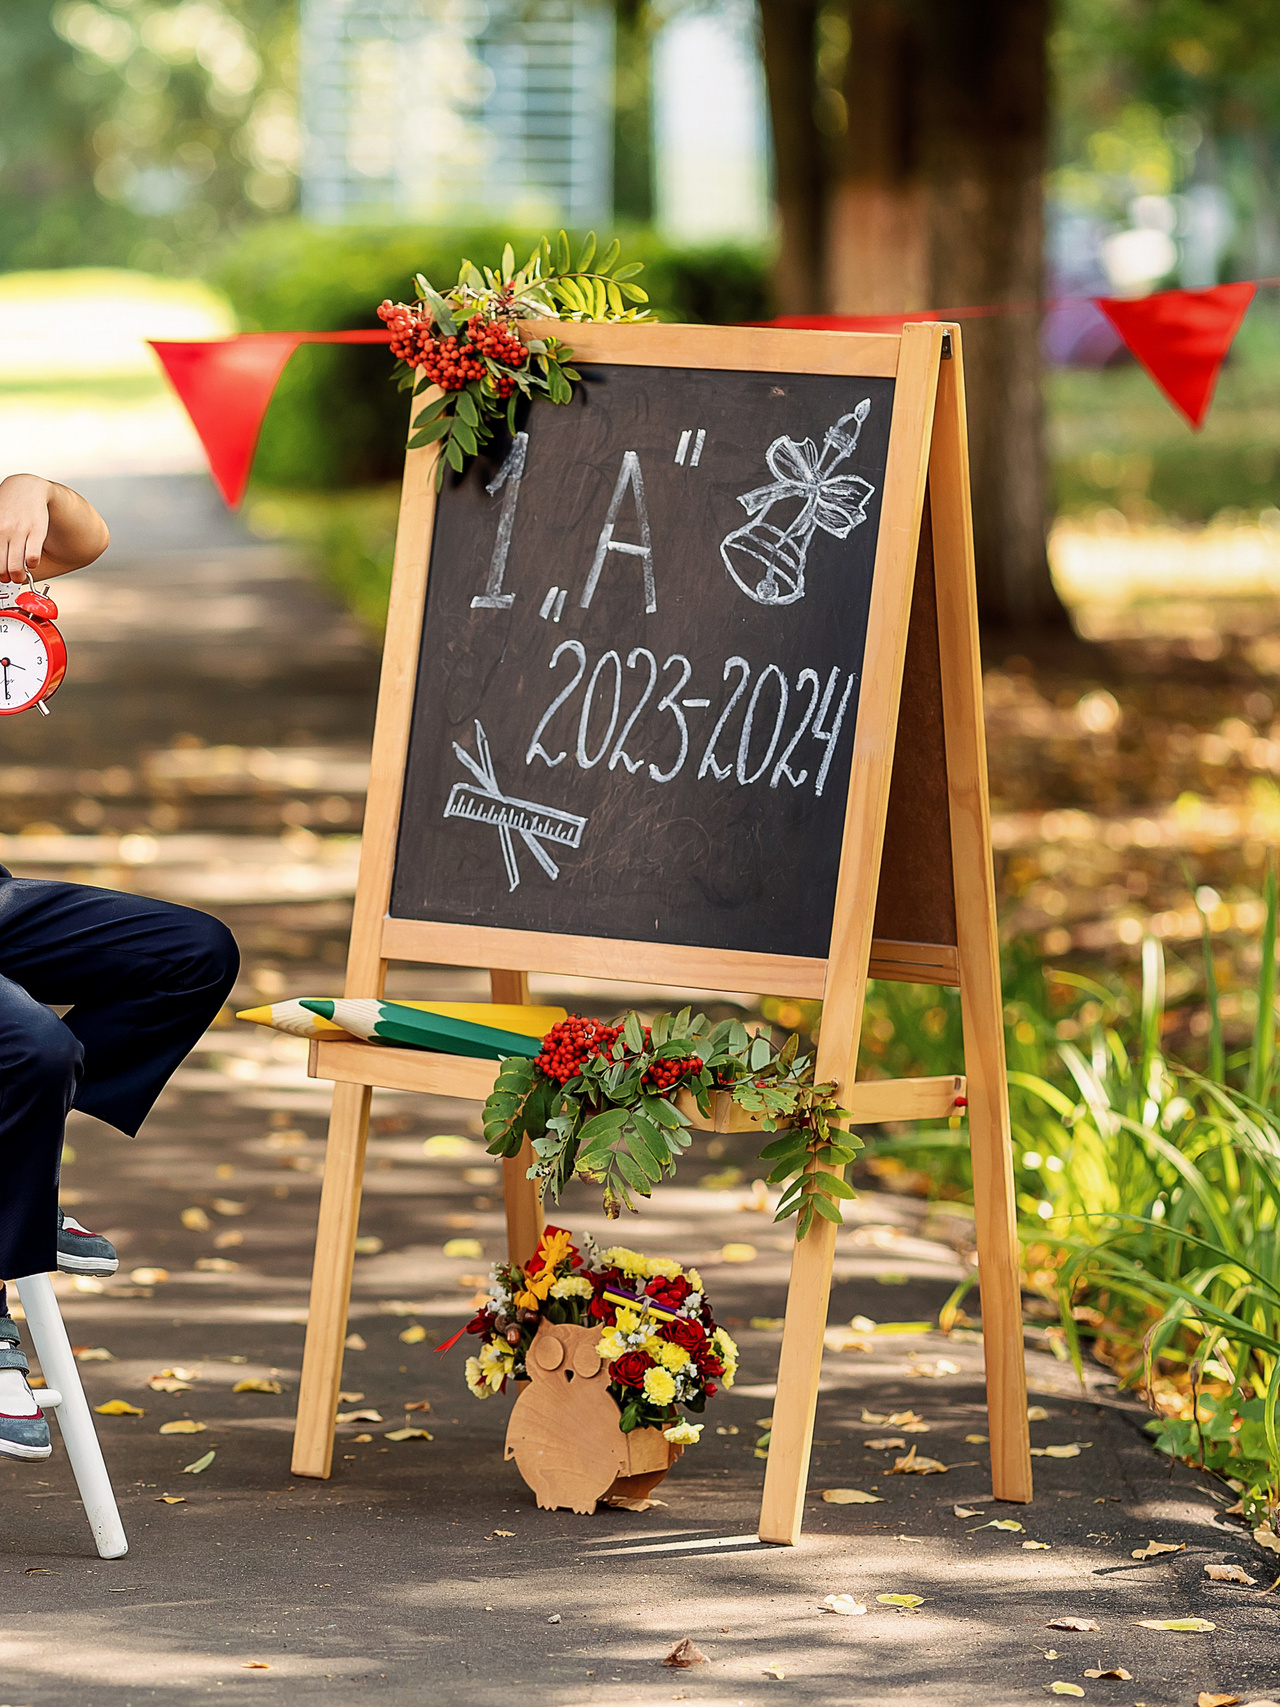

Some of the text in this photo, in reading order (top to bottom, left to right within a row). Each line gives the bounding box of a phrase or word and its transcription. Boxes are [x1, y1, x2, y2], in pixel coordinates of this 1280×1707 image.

[0, 624, 9, 633] 12
[36, 656, 43, 665] 3
[525, 640, 858, 797] 2023-2024
